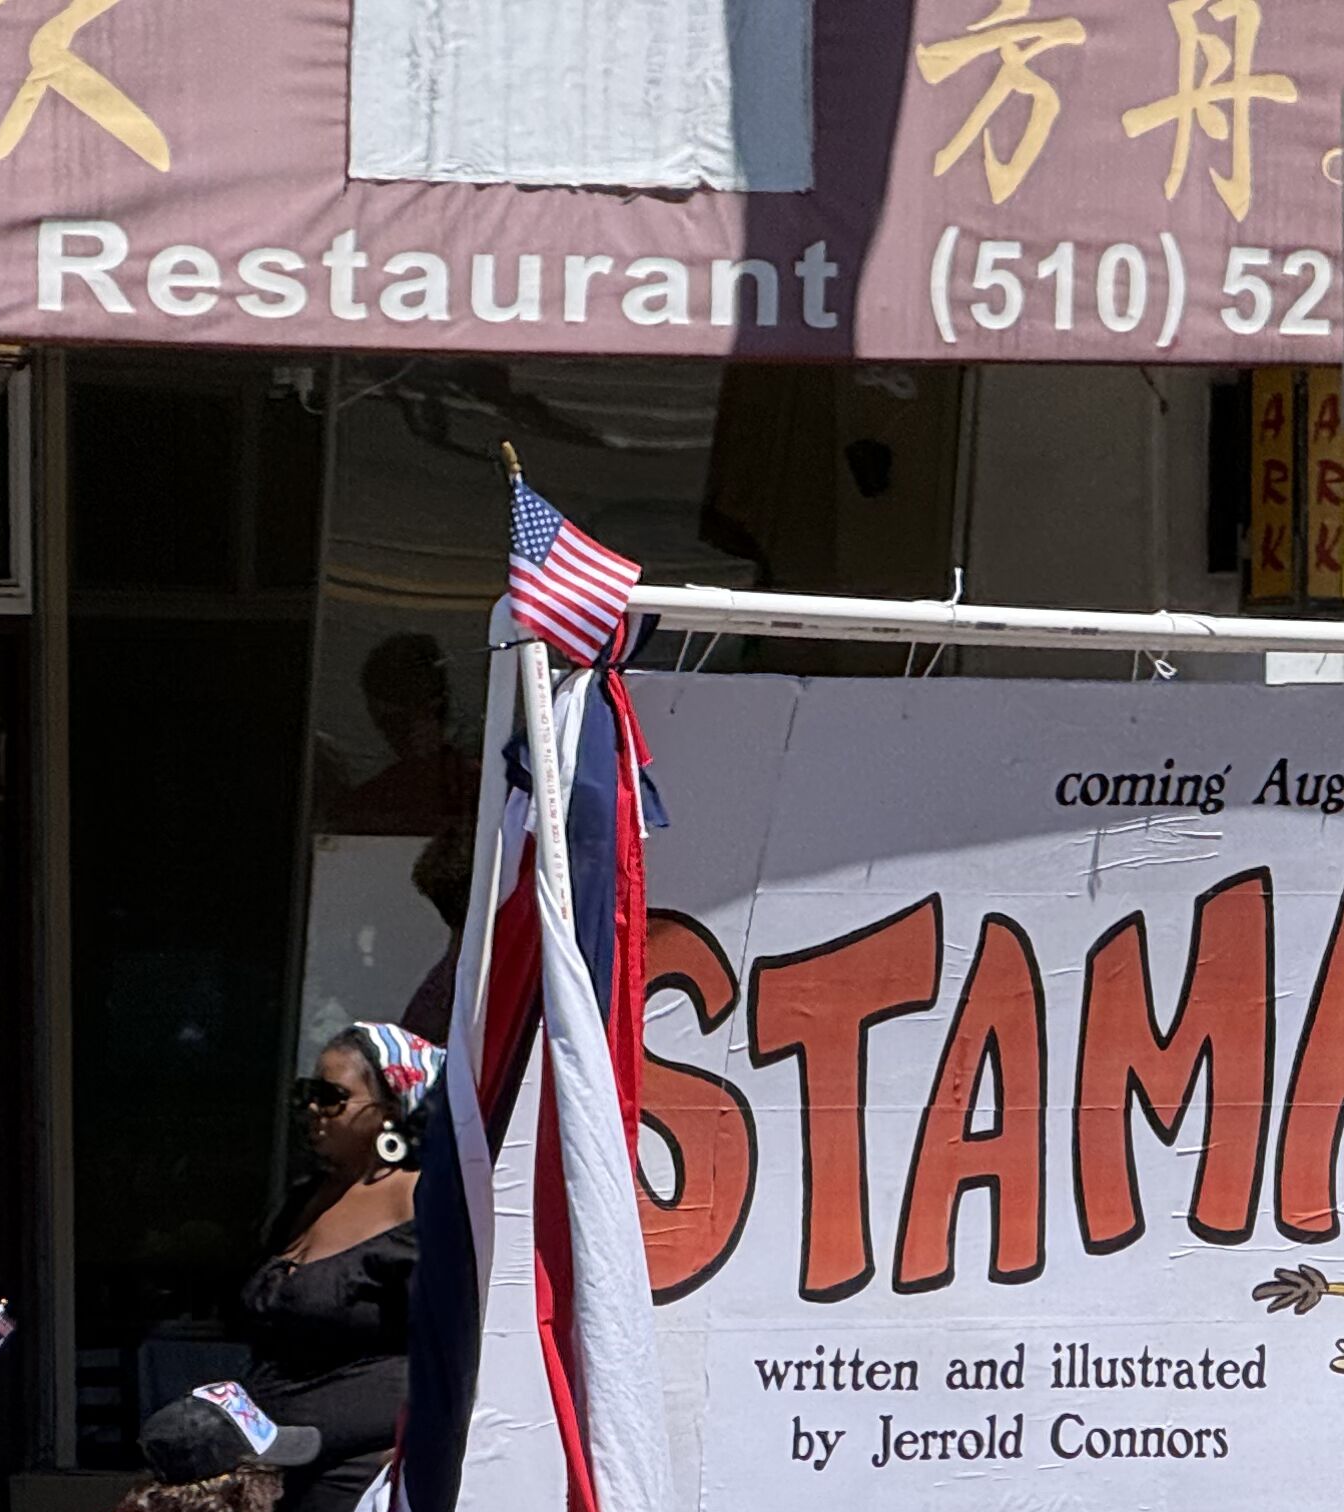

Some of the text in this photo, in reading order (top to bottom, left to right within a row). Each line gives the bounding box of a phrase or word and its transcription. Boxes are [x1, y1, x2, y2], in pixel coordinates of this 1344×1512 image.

[37, 218, 840, 330] Restaurant
[930, 226, 1186, 347] (510)
[1056, 759, 1230, 815] coming
[754, 1342, 1268, 1393] written and illustrated
[791, 1413, 1230, 1472] by Jerrold Connors
